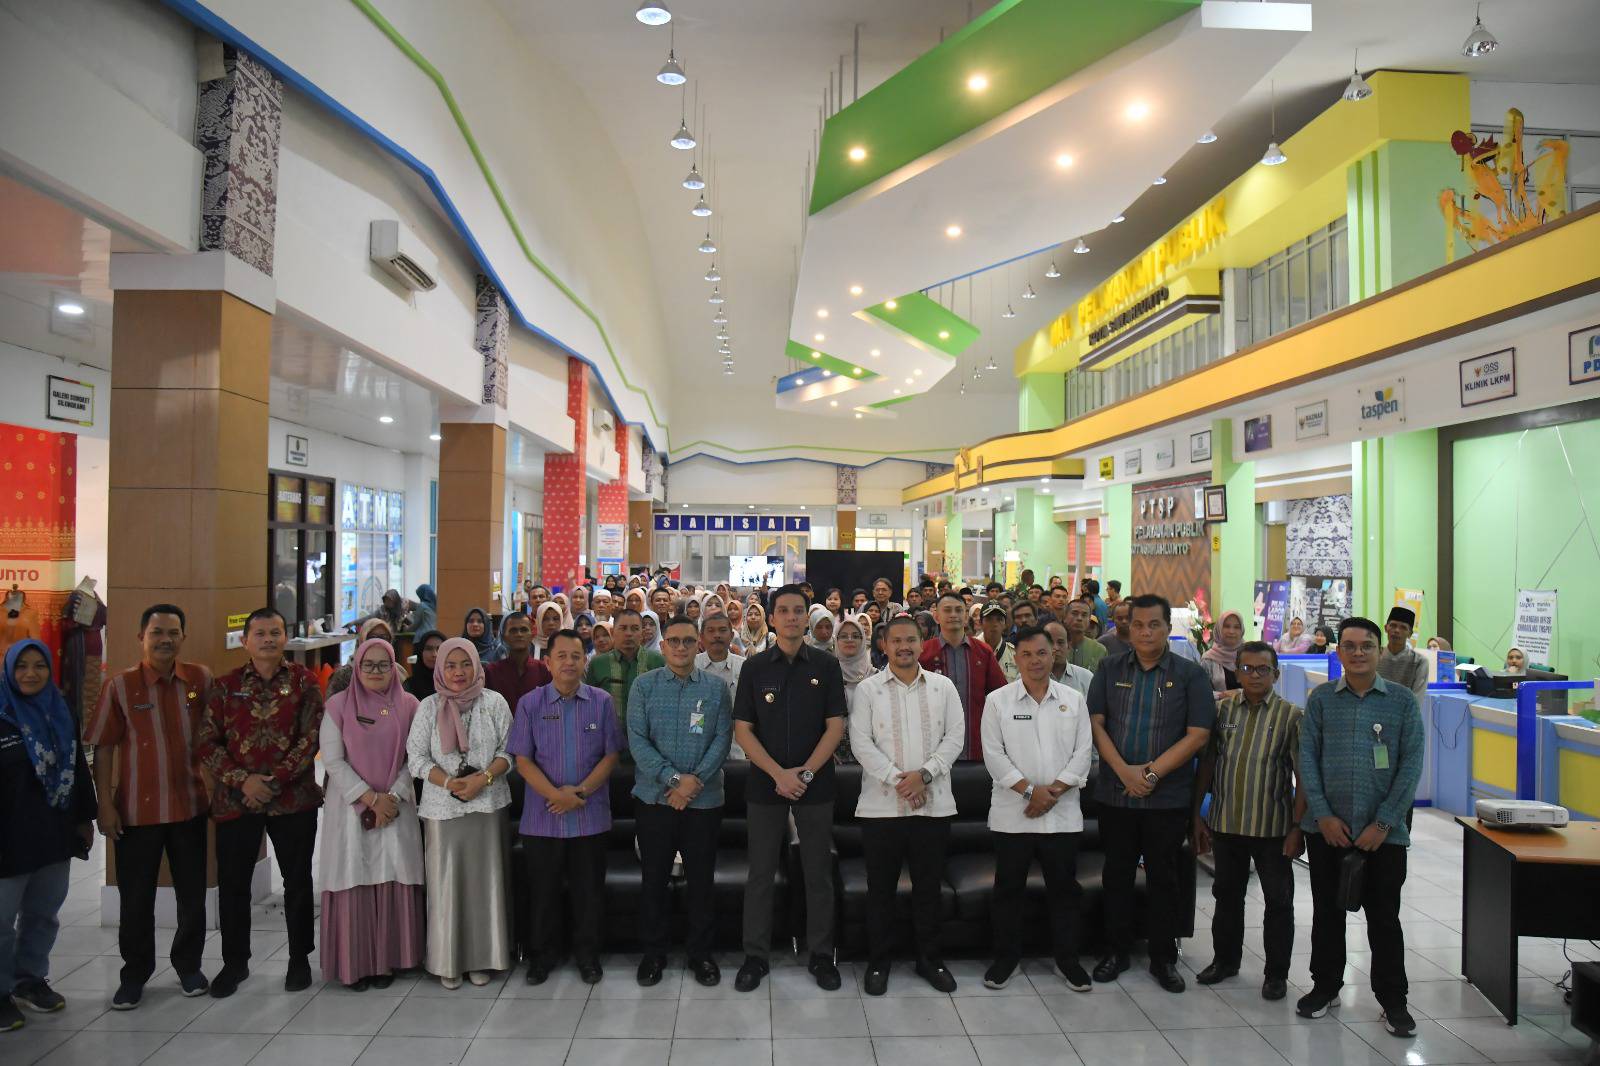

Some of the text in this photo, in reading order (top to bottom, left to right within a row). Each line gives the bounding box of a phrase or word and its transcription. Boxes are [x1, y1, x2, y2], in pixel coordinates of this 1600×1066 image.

[1158, 197, 1227, 274] PUBLIK
[1464, 373, 1511, 392] KLINIK LKPM
[1361, 399, 1398, 420] taspen
[342, 490, 387, 527] ATM
[1140, 496, 1174, 518] PTSP
[663, 516, 801, 529] SAMSAT
[1175, 519, 1206, 538] PUBLIK
